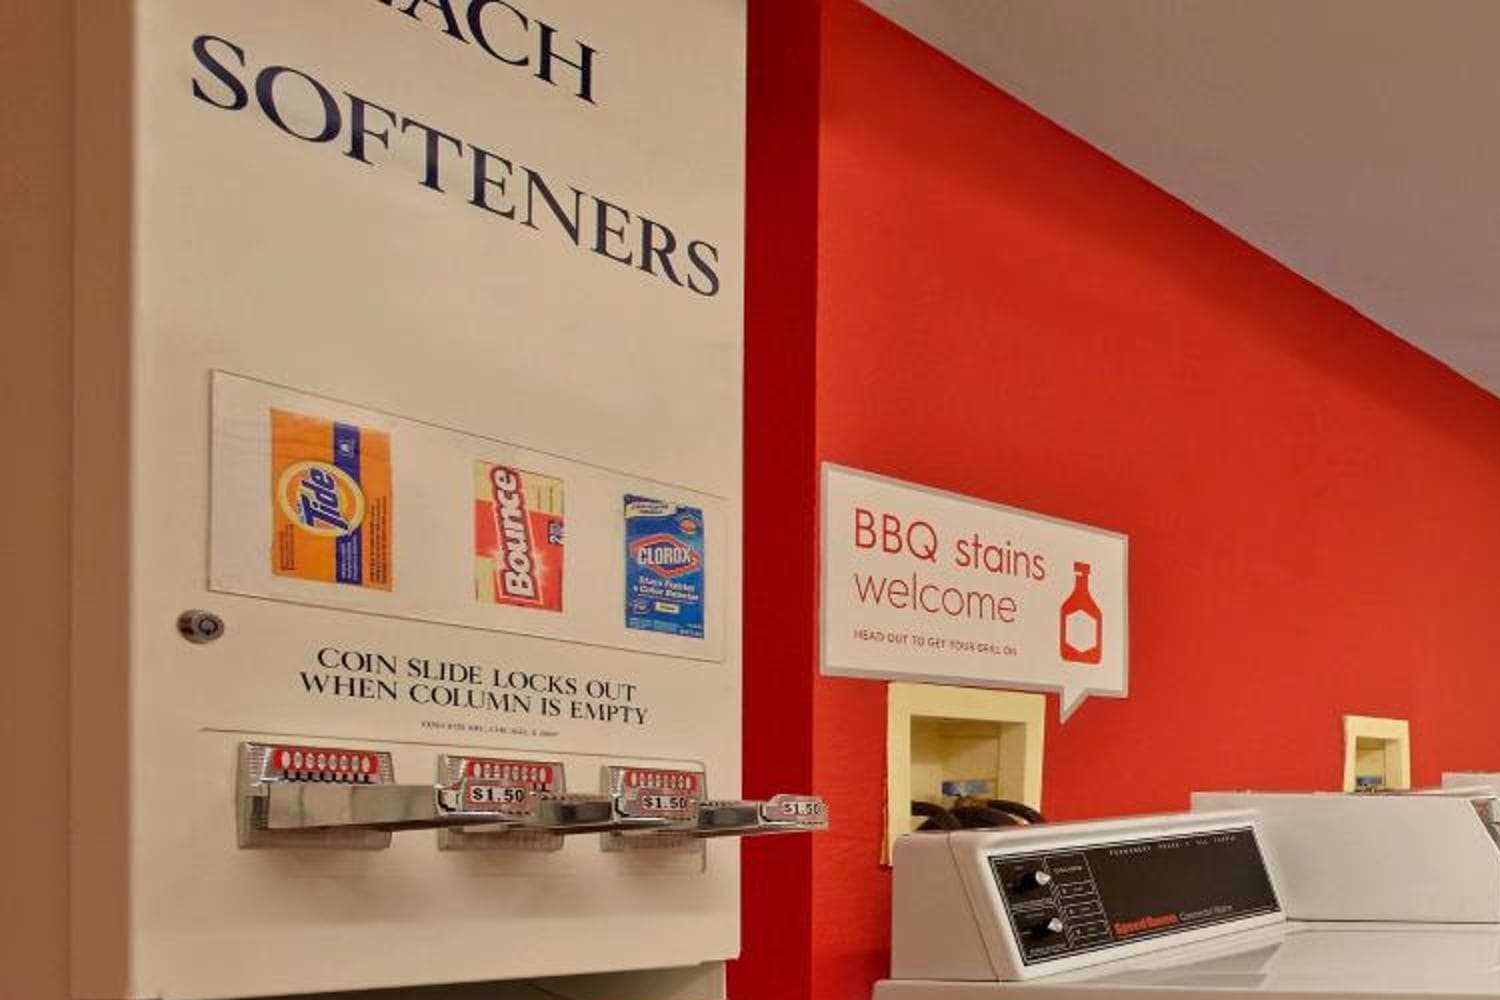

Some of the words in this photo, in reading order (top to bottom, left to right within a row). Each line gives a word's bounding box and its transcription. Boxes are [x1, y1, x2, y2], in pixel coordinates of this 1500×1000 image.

[191, 34, 721, 298] SOFTENERS
[300, 466, 350, 531] Tide
[495, 469, 535, 597] Bounce
[638, 546, 691, 566] CLOROX
[854, 507, 938, 563] BBQ
[955, 533, 1046, 581] stains
[855, 572, 1018, 623] welcome
[853, 629, 885, 641] HEAD
[888, 632, 909, 644] OUT
[912, 635, 925, 647] TO
[928, 637, 946, 649] GET
[949, 640, 975, 652] YOUR
[1003, 645, 1017, 656] ON
[300, 671, 399, 701] WHEN
[409, 683, 532, 716] COLUMN
[541, 699, 561, 717] IS
[570, 703, 649, 726] EMPTY
[316, 647, 398, 675] COIN
[407, 658, 484, 684] SLIDE
[493, 669, 578, 696] LOCKS
[586, 680, 637, 702] OUT
[472, 787, 525, 802] $1.50
[642, 796, 688, 810] $1.50
[783, 803, 821, 815] $1.50
